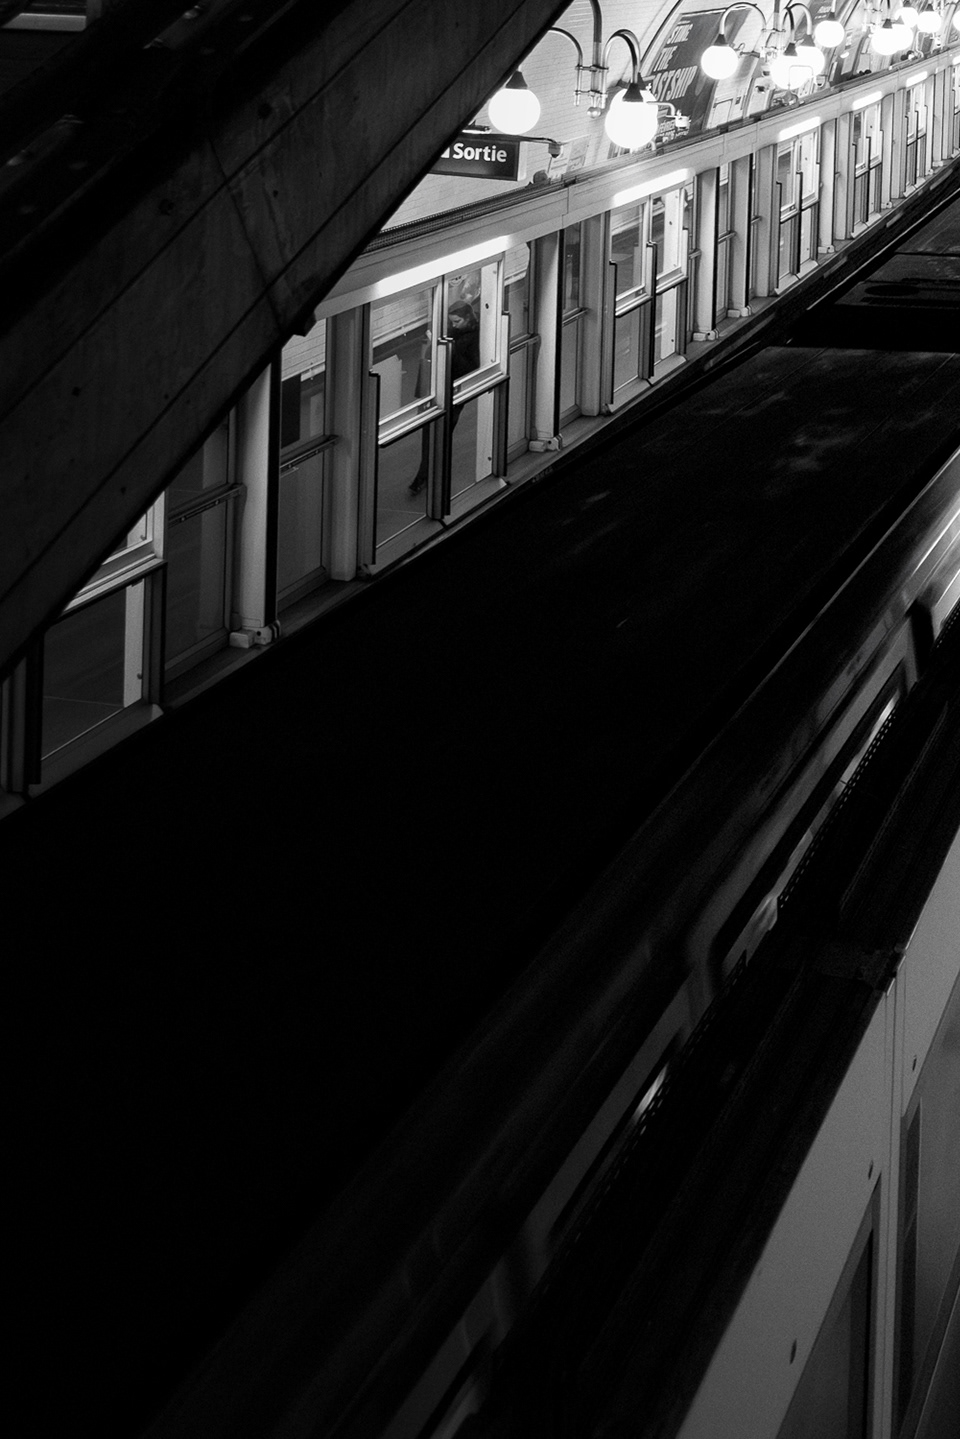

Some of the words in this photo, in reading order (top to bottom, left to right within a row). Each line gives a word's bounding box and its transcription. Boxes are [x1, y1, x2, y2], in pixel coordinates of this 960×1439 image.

[653, 45, 678, 72] THE
[666, 65, 698, 101] SHIP
[452, 142, 508, 163] Sortie
